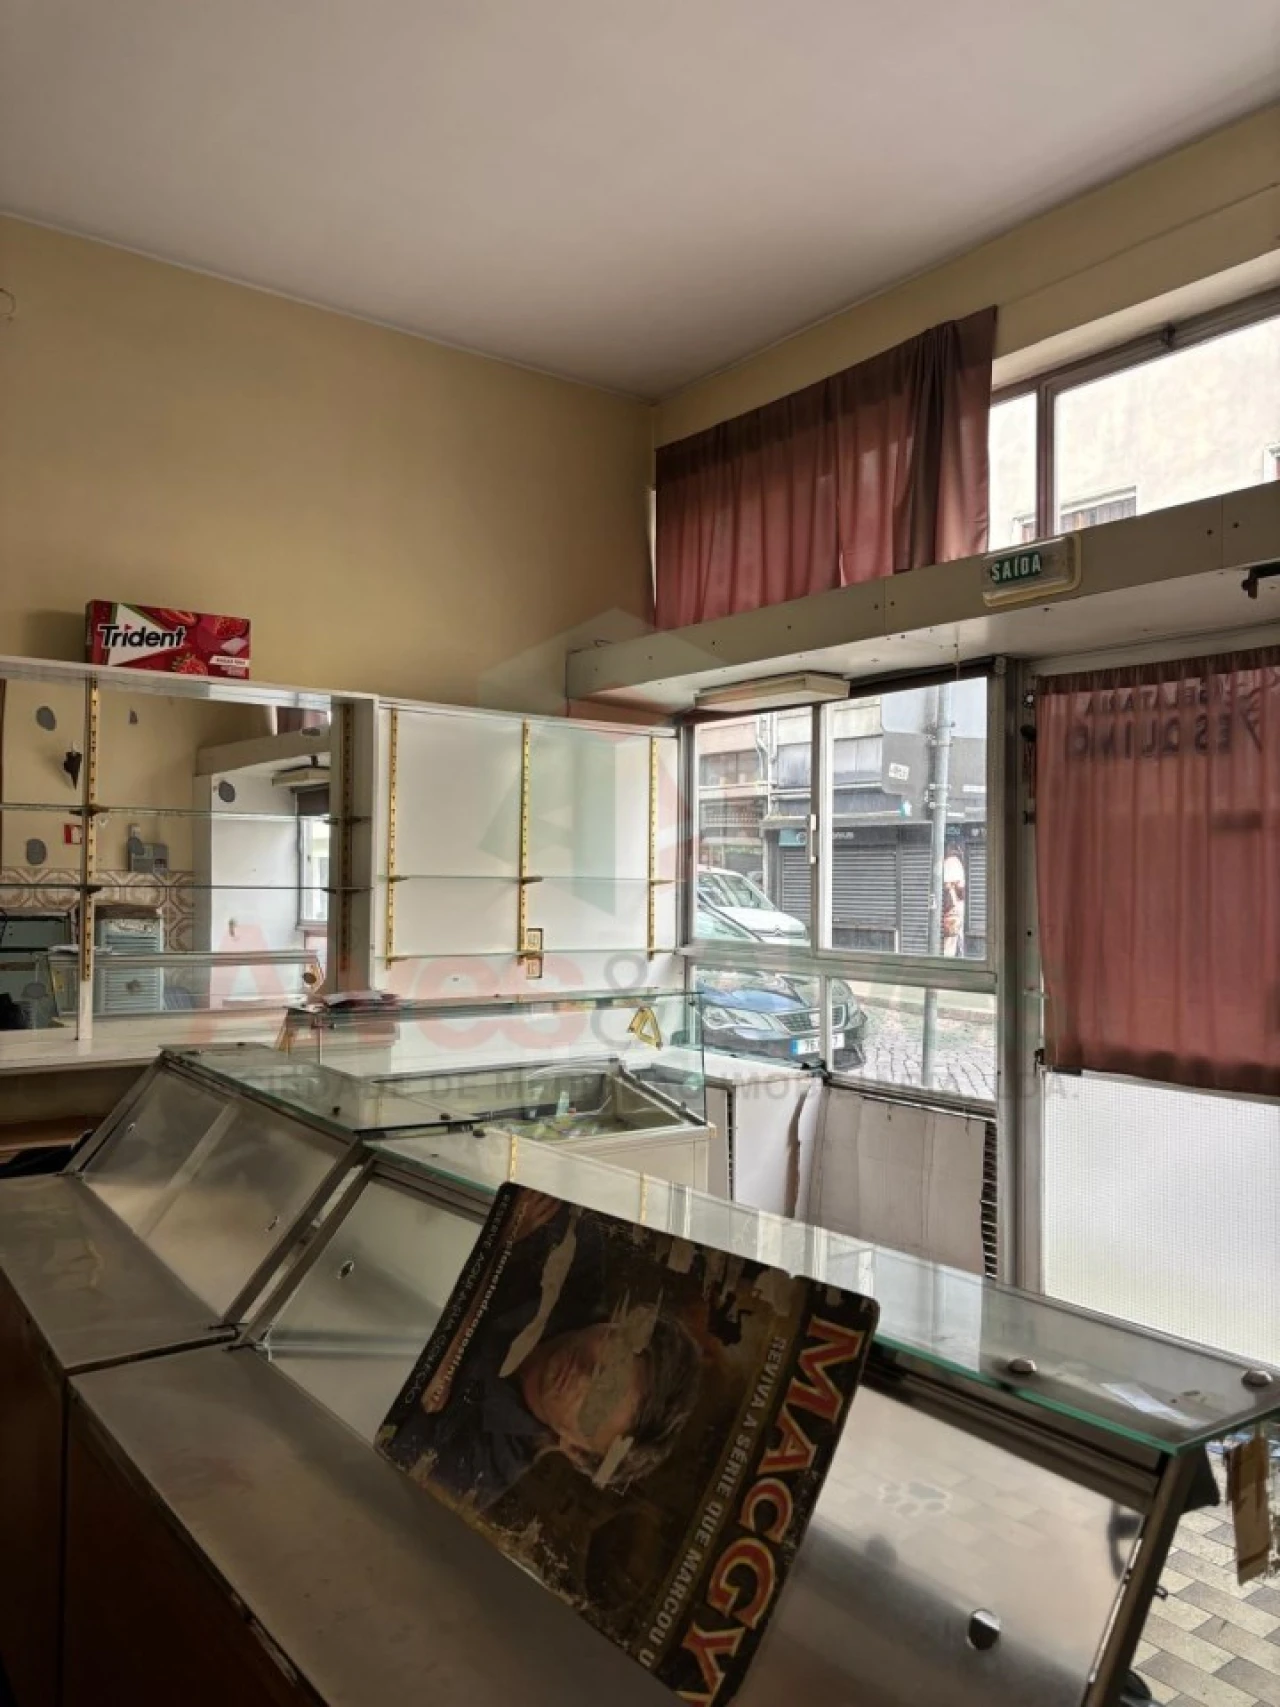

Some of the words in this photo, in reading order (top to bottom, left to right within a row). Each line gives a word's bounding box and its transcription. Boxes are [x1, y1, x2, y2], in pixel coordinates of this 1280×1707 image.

[99, 624, 186, 648] Trident
[752, 1336, 788, 1411] REVIVA
[743, 1411, 757, 1429] A
[716, 1431, 754, 1497] SÉRIE
[695, 1503, 725, 1546] QUE
[647, 1549, 703, 1648] MARCOU
